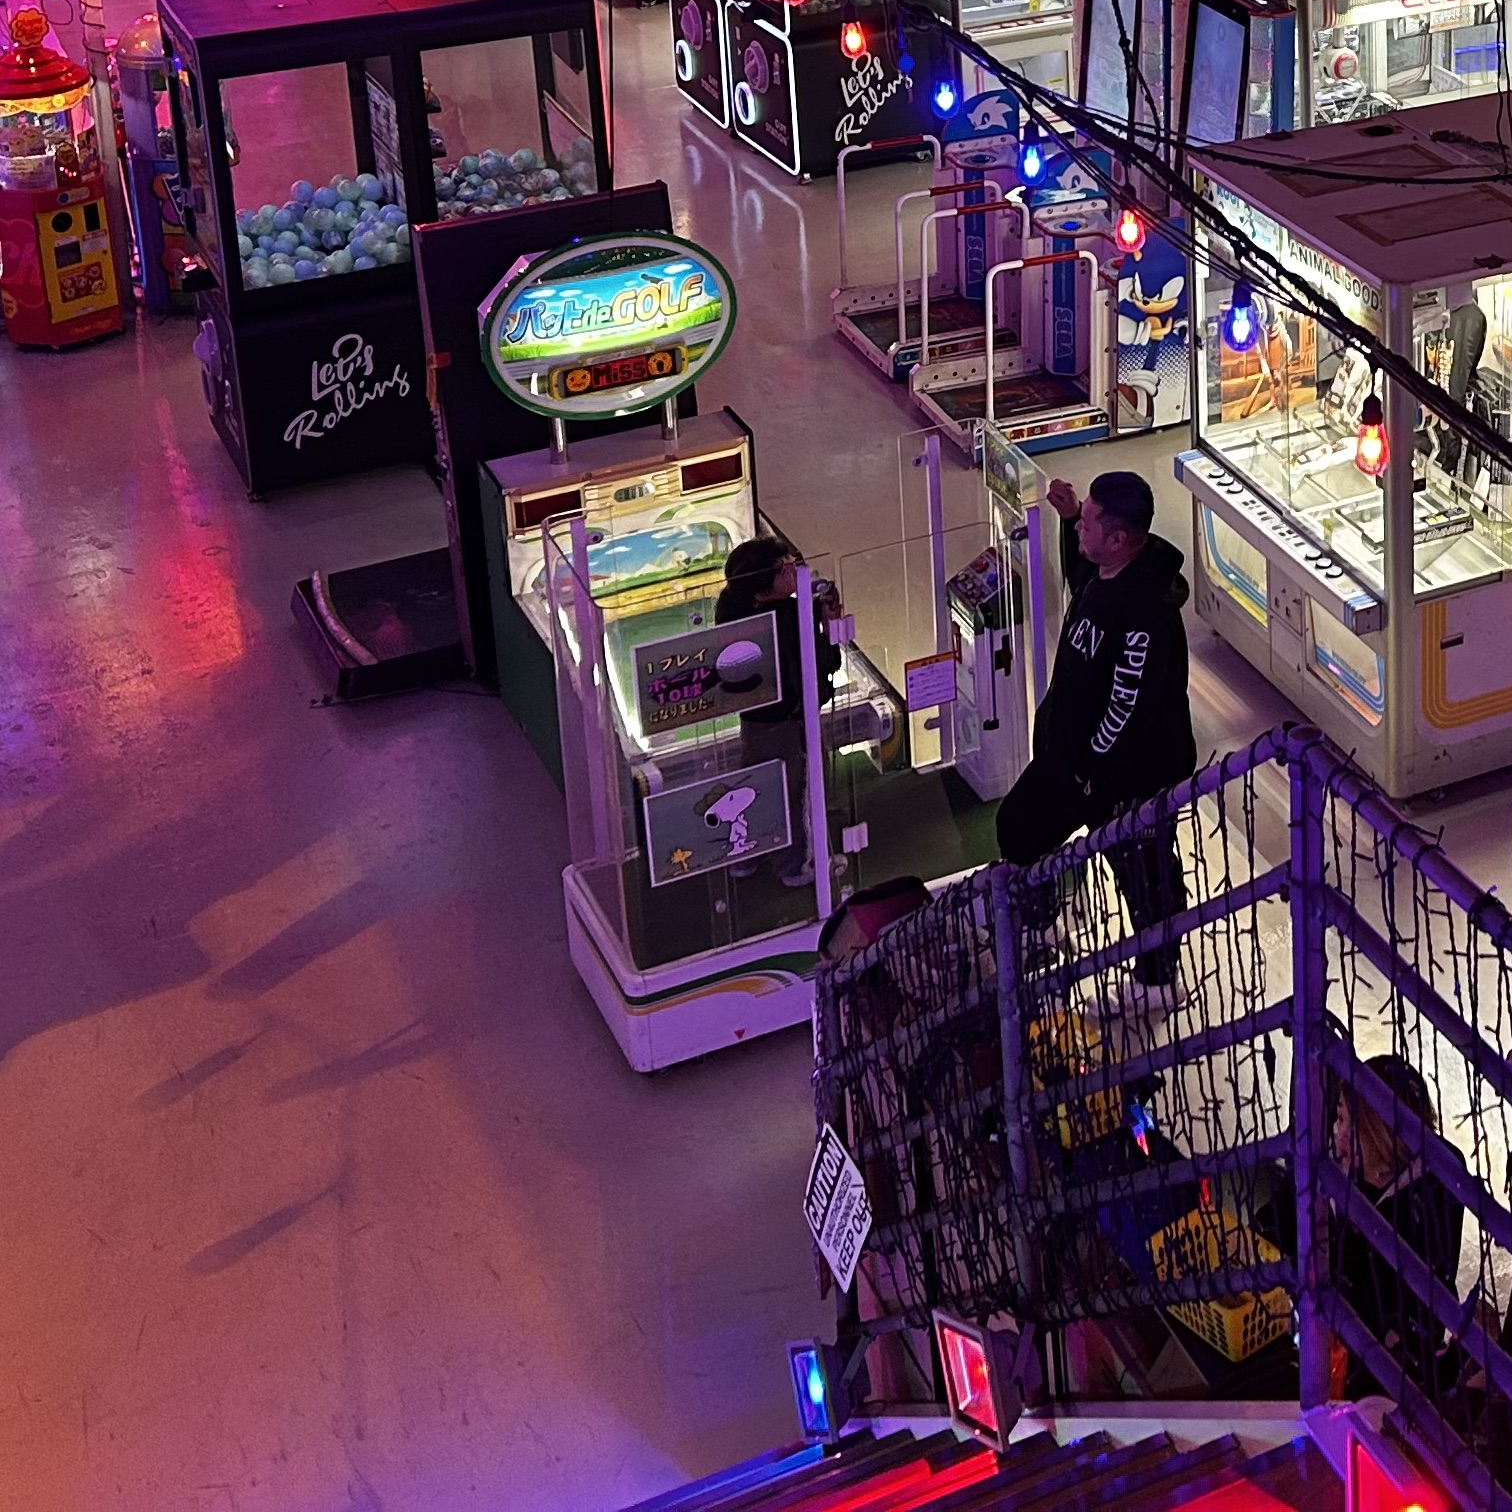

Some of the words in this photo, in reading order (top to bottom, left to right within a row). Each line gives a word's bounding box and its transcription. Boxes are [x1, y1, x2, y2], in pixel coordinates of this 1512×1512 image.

[1289, 239, 1341, 285] ANIMAL
[312, 333, 374, 401] Let's
[283, 364, 411, 449] Rolling
[808, 1137, 844, 1231] CAUTION
[836, 1233, 856, 1282] KEEP
